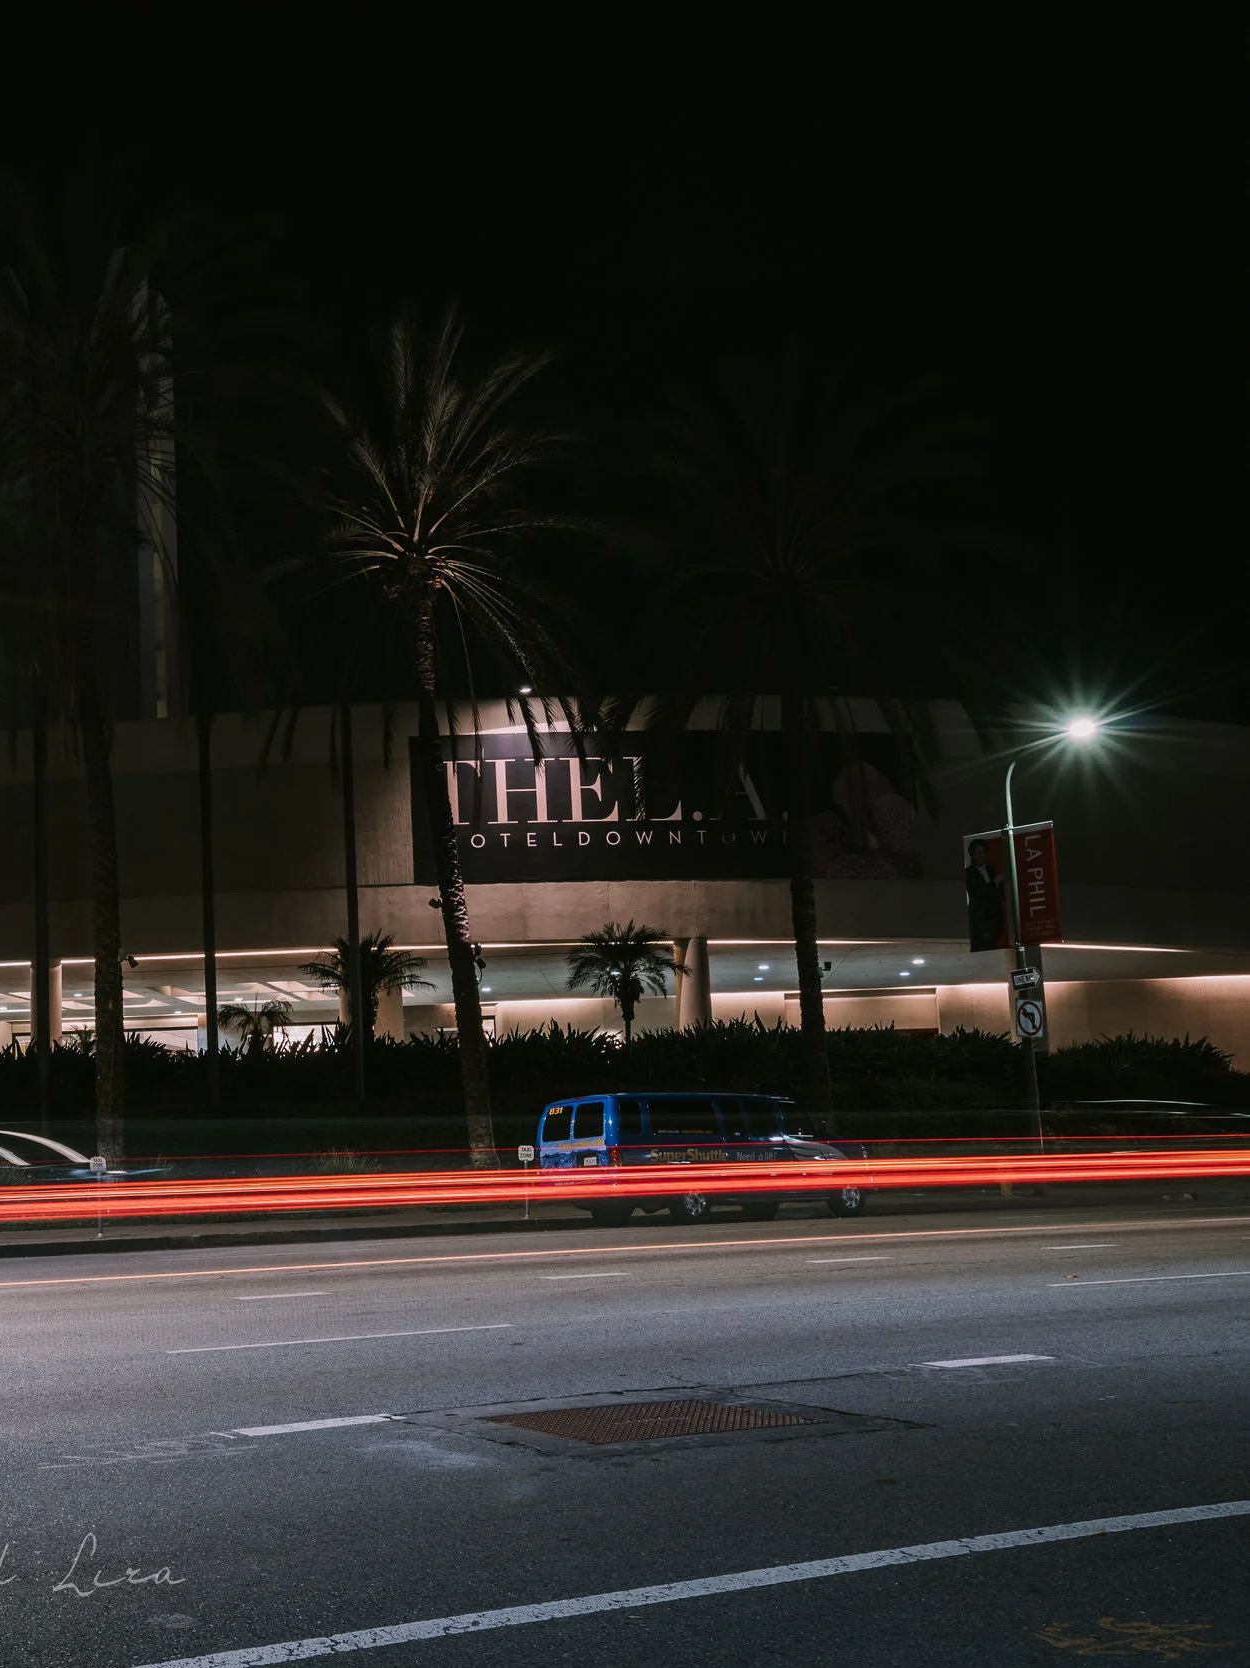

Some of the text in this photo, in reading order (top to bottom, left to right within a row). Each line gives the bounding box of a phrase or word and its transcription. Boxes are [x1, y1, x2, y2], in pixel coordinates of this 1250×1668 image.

[1025, 835, 1042, 861] LA
[1027, 867, 1047, 918] PHIL
[1015, 976, 1025, 984] ONE
[549, 1107, 563, 1116] 831
[650, 1148, 727, 1162] SuperShuttle
[736, 1152, 755, 1161] Need
